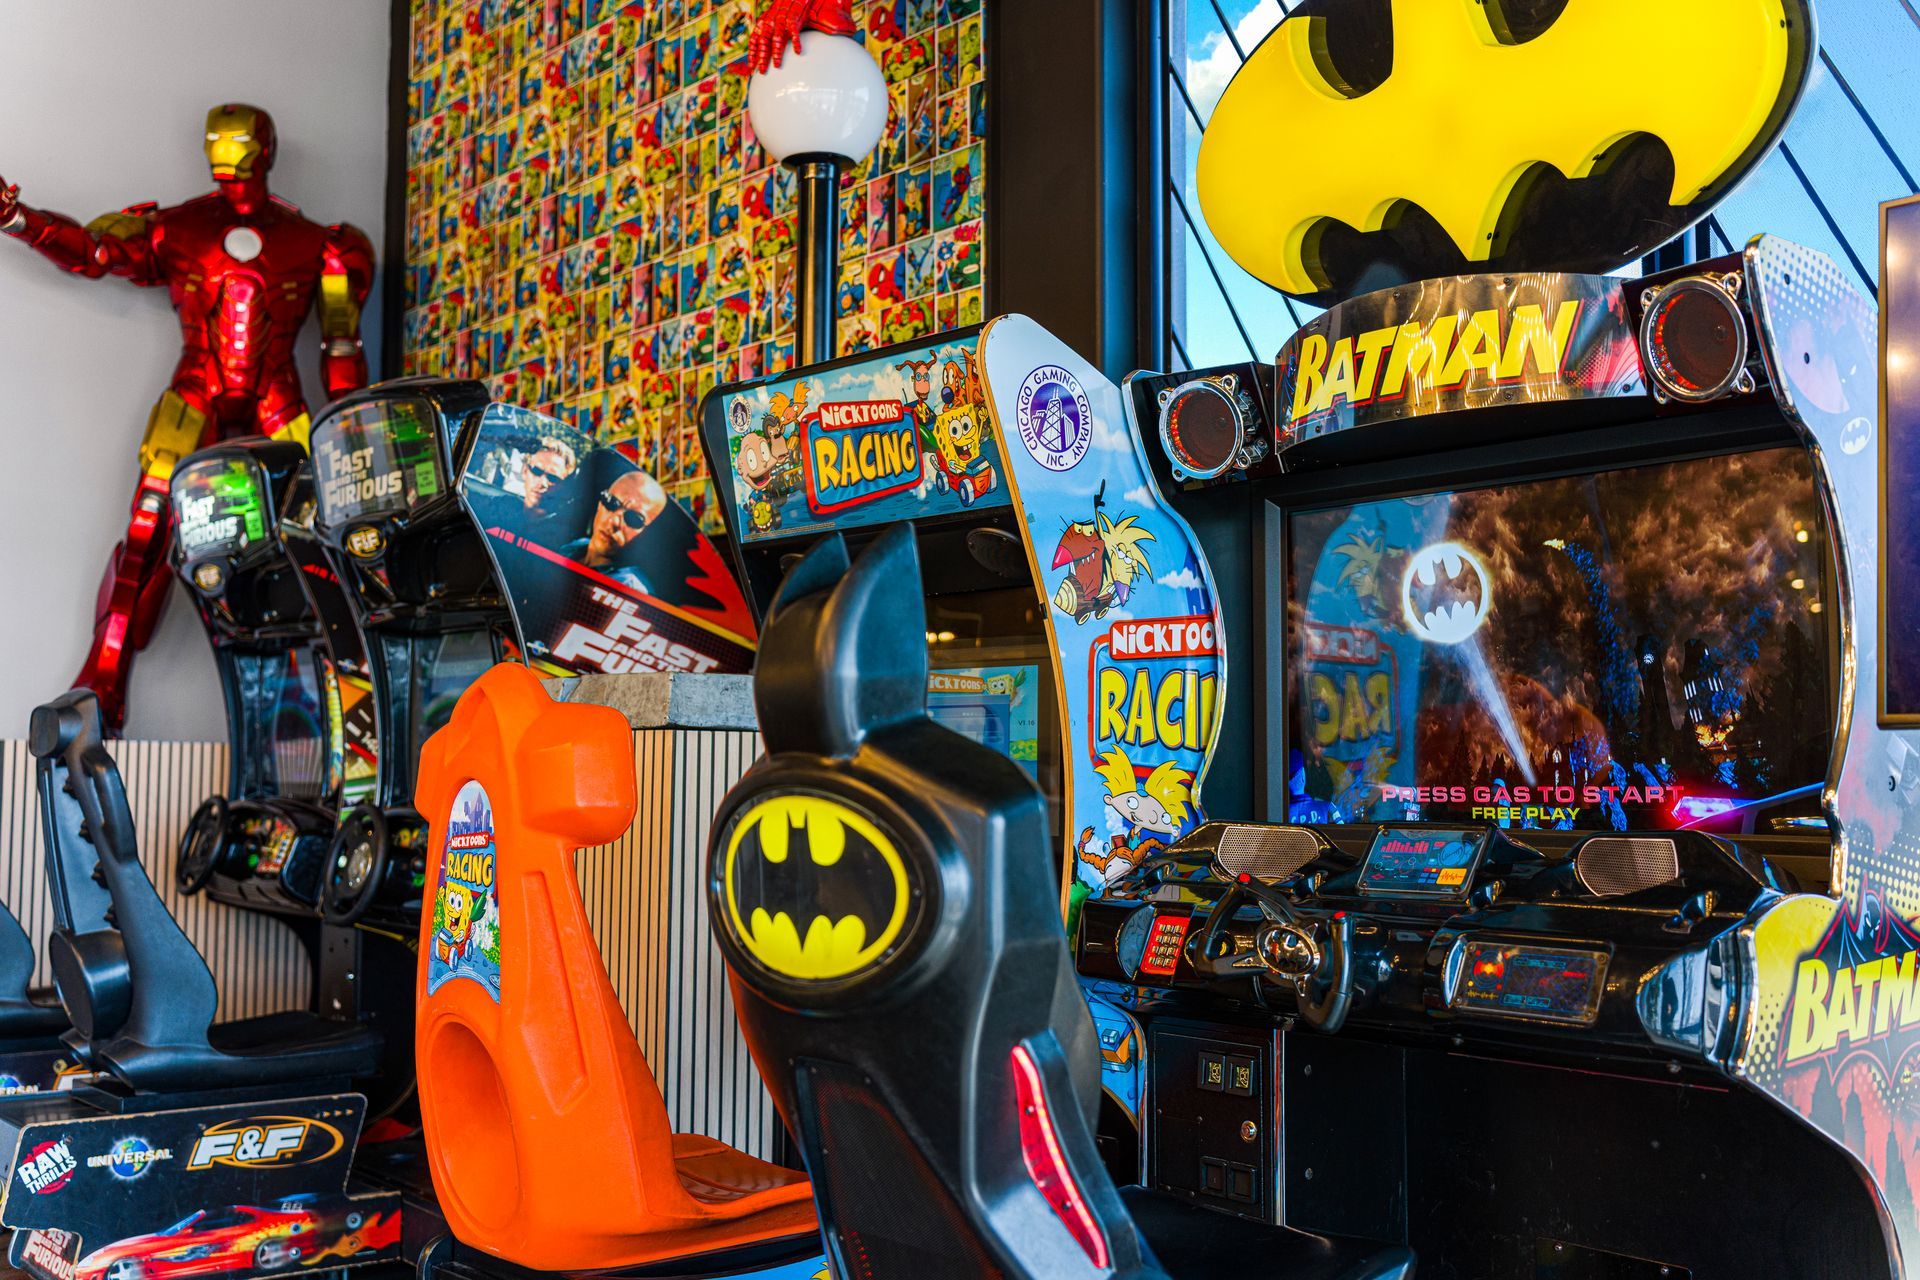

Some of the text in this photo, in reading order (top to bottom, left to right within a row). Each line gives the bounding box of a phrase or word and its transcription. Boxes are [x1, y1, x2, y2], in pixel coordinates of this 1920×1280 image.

[1291, 300, 1580, 422] BATMAN
[1020, 368, 1090, 460] CHICAGO GAMING COMPANY
[329, 446, 374, 479] FAST
[814, 429, 916, 492] RACING
[1046, 453, 1068, 467] INC.
[324, 470, 402, 516] FURIOUS
[592, 586, 640, 616] THE
[603, 611, 719, 673] FAST
[612, 643, 656, 666] AND
[1382, 786, 1686, 803] PRESS GAS TO START
[1472, 807, 1581, 820] FREE PLAY
[447, 852, 493, 886] RACING
[1786, 949, 1920, 1061] BATM
[17, 1139, 71, 1184] RAW
[87, 1149, 173, 1168] UNIVERSAL
[190, 1125, 306, 1167] F&F
[26, 1155, 78, 1194] THRILLS
